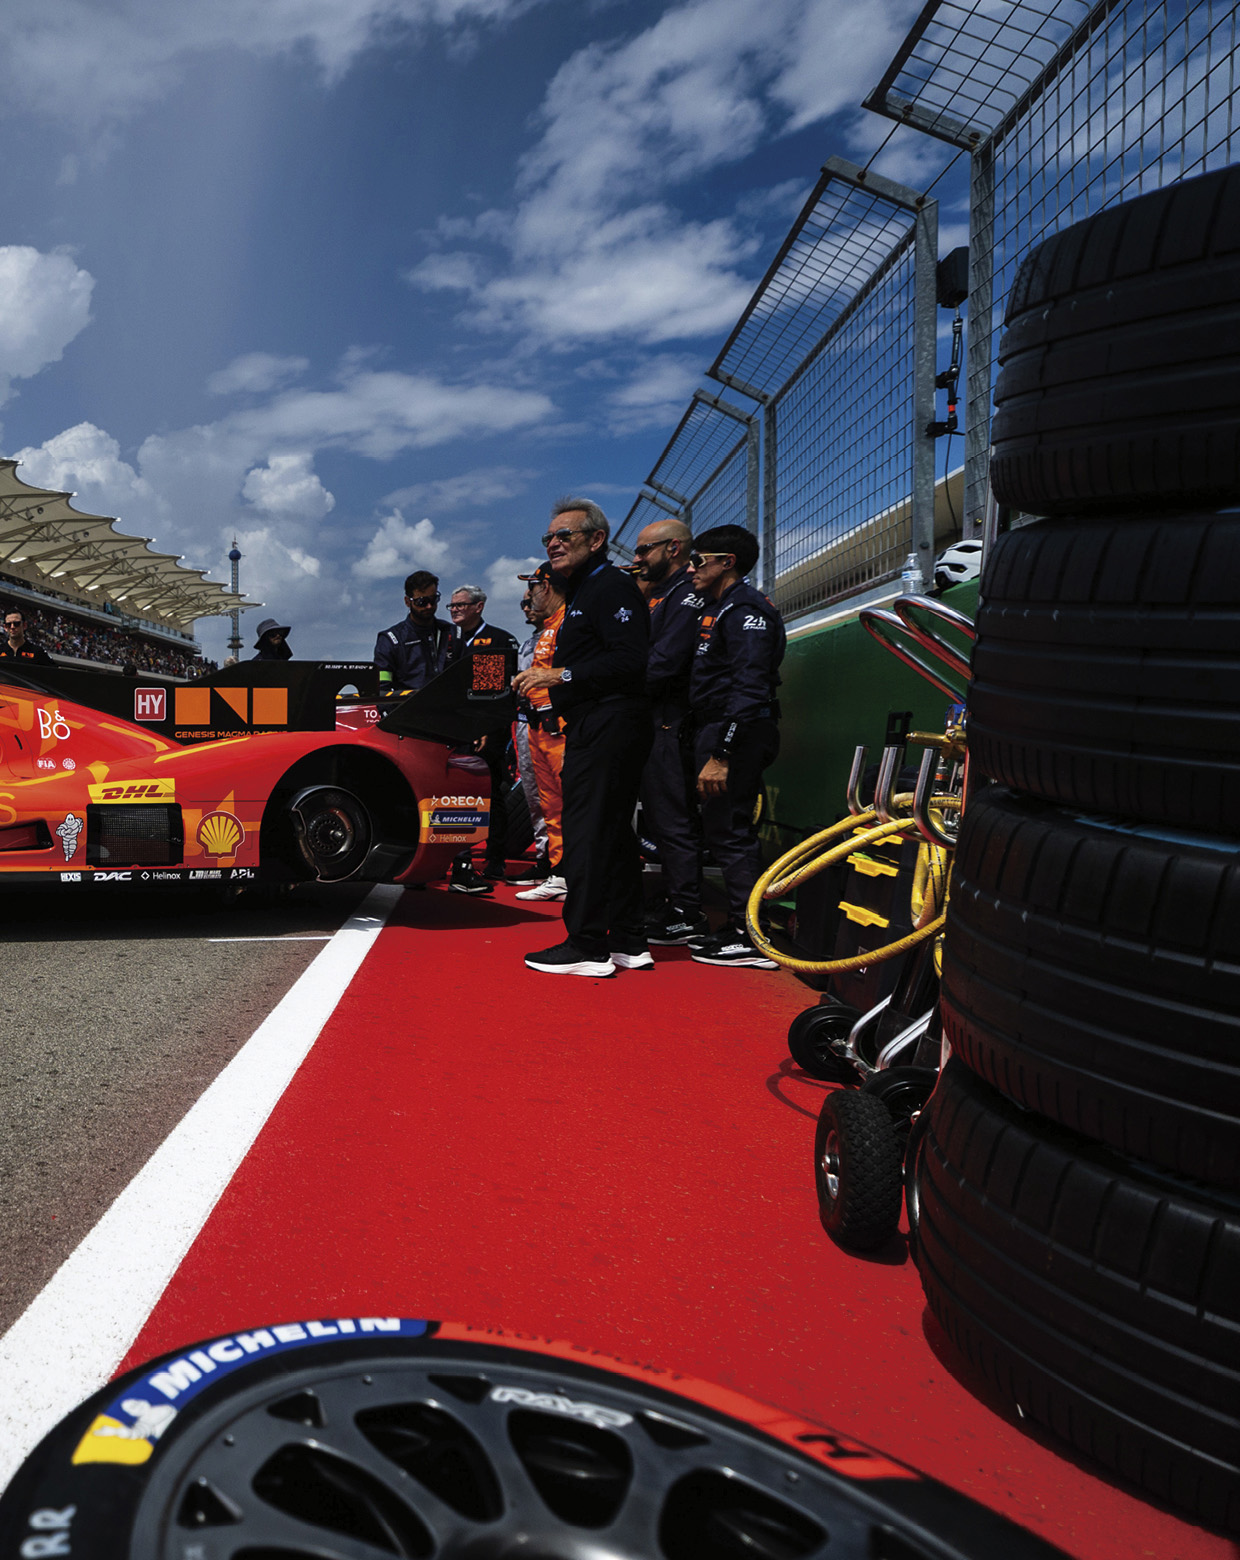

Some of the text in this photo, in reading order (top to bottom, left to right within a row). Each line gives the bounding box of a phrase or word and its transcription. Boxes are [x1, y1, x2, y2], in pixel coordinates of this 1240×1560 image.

[137, 694, 163, 714] HY
[38, 759, 56, 769] FIA
[101, 785, 164, 800] DHL
[440, 796, 484, 806] ORECA
[94, 872, 132, 881] DAC
[152, 872, 181, 880] Helinox
[149, 1318, 401, 1400] MICHELIN
